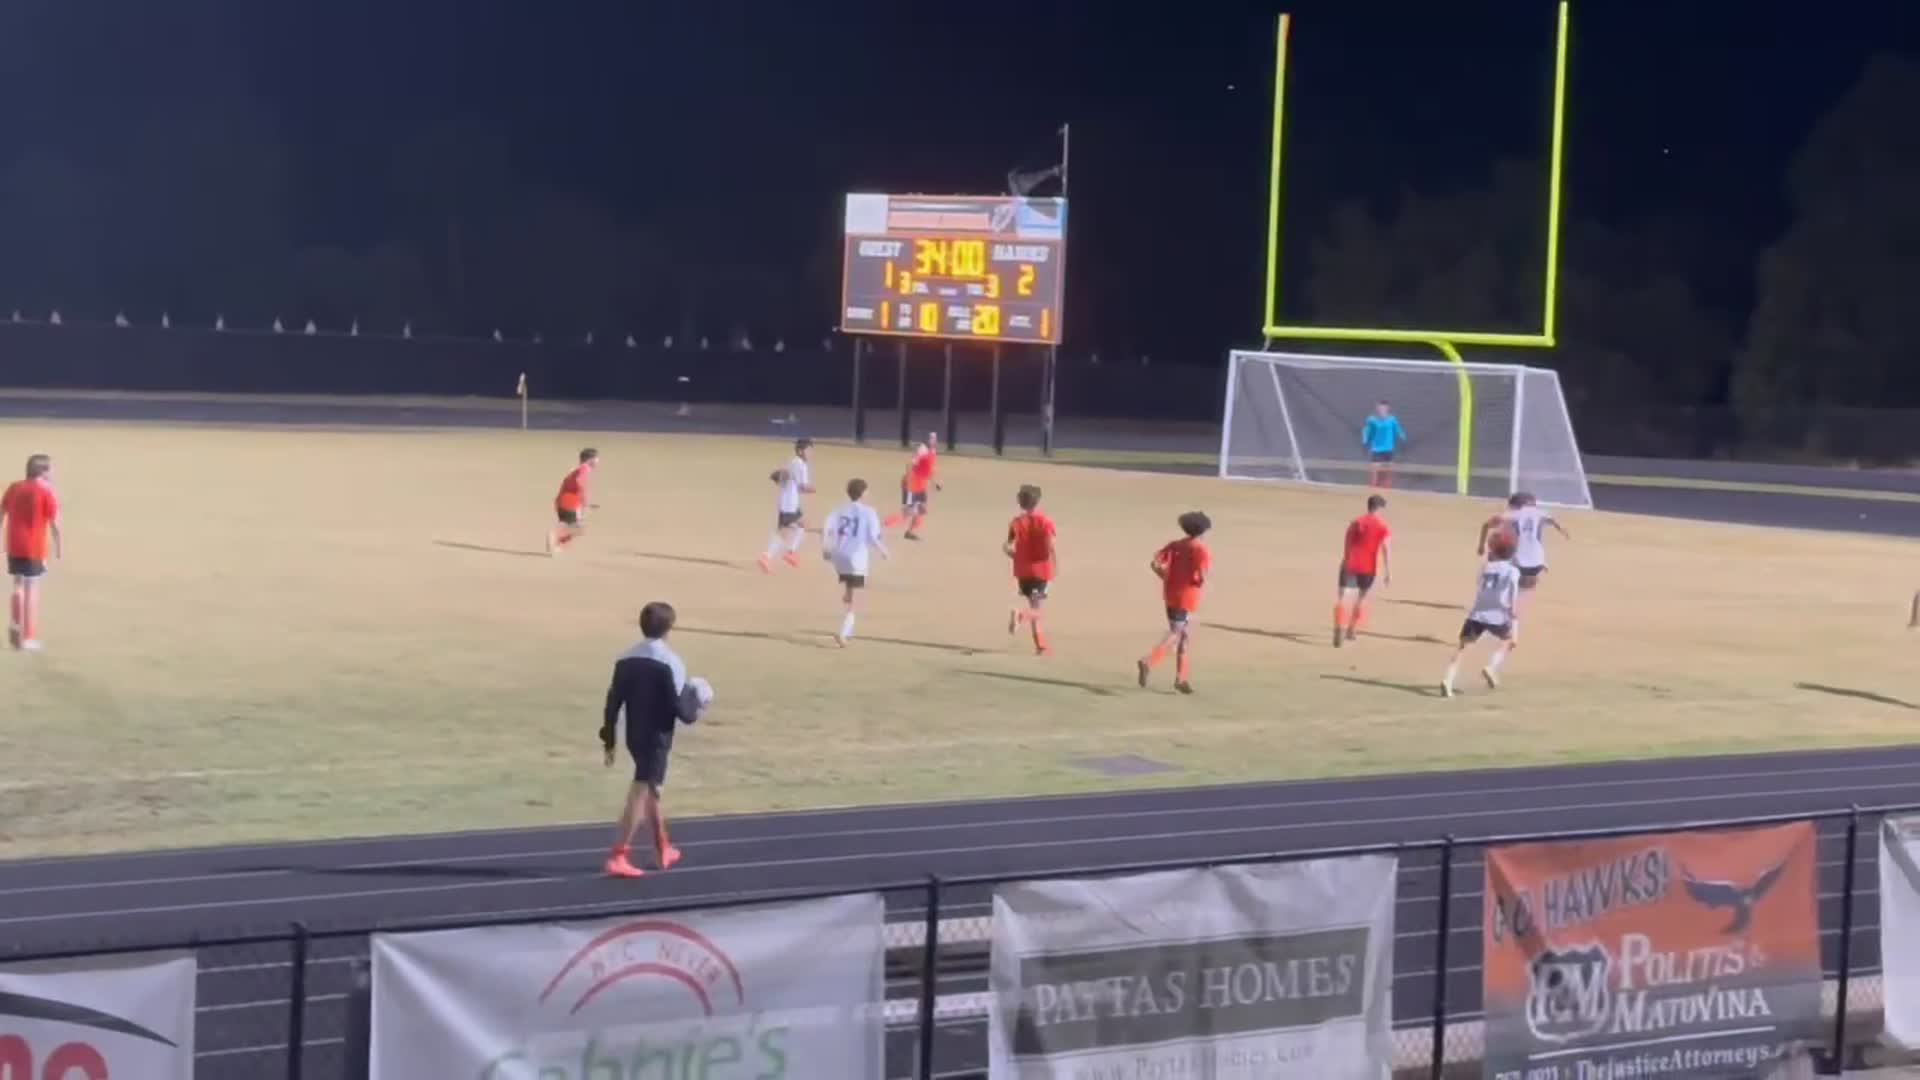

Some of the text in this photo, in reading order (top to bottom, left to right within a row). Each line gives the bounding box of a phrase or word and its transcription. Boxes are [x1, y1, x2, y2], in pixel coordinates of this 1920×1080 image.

[1017, 264, 1035, 295] 2
[838, 516, 859, 537] 21
[1200, 954, 1357, 1008] HOMES
